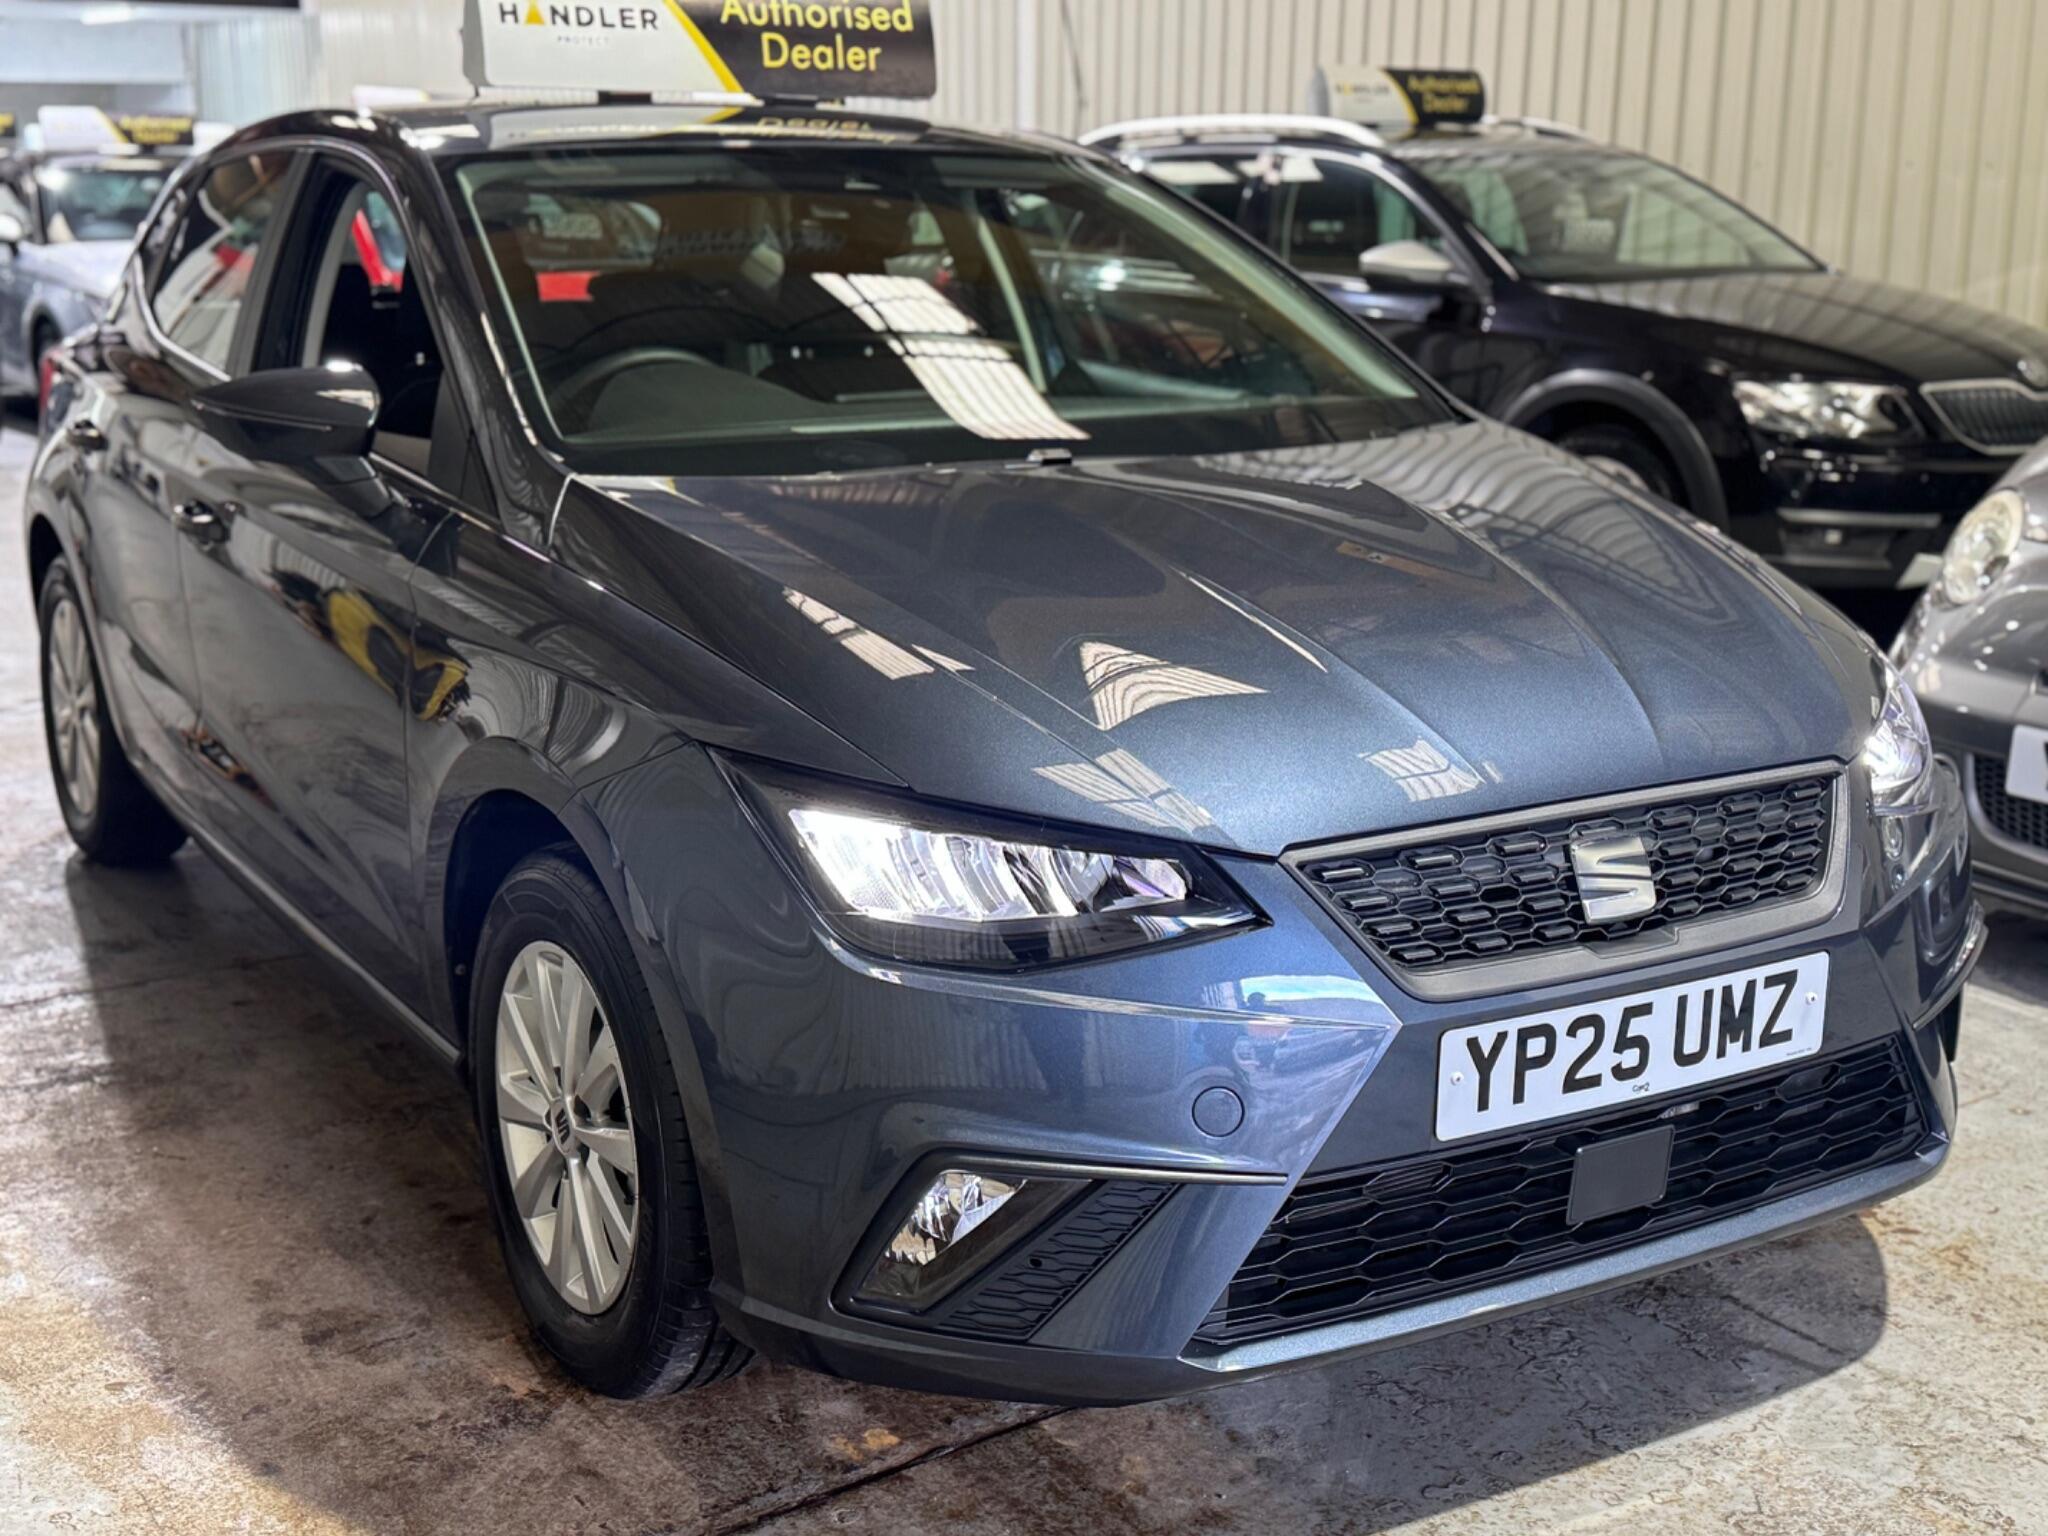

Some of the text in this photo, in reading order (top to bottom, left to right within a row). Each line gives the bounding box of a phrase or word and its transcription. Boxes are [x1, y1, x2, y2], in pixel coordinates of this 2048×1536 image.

[720, 0, 914, 32] Authorised
[760, 31, 882, 72] Dealer
[1466, 969, 1799, 1113] YP25 UMZ
